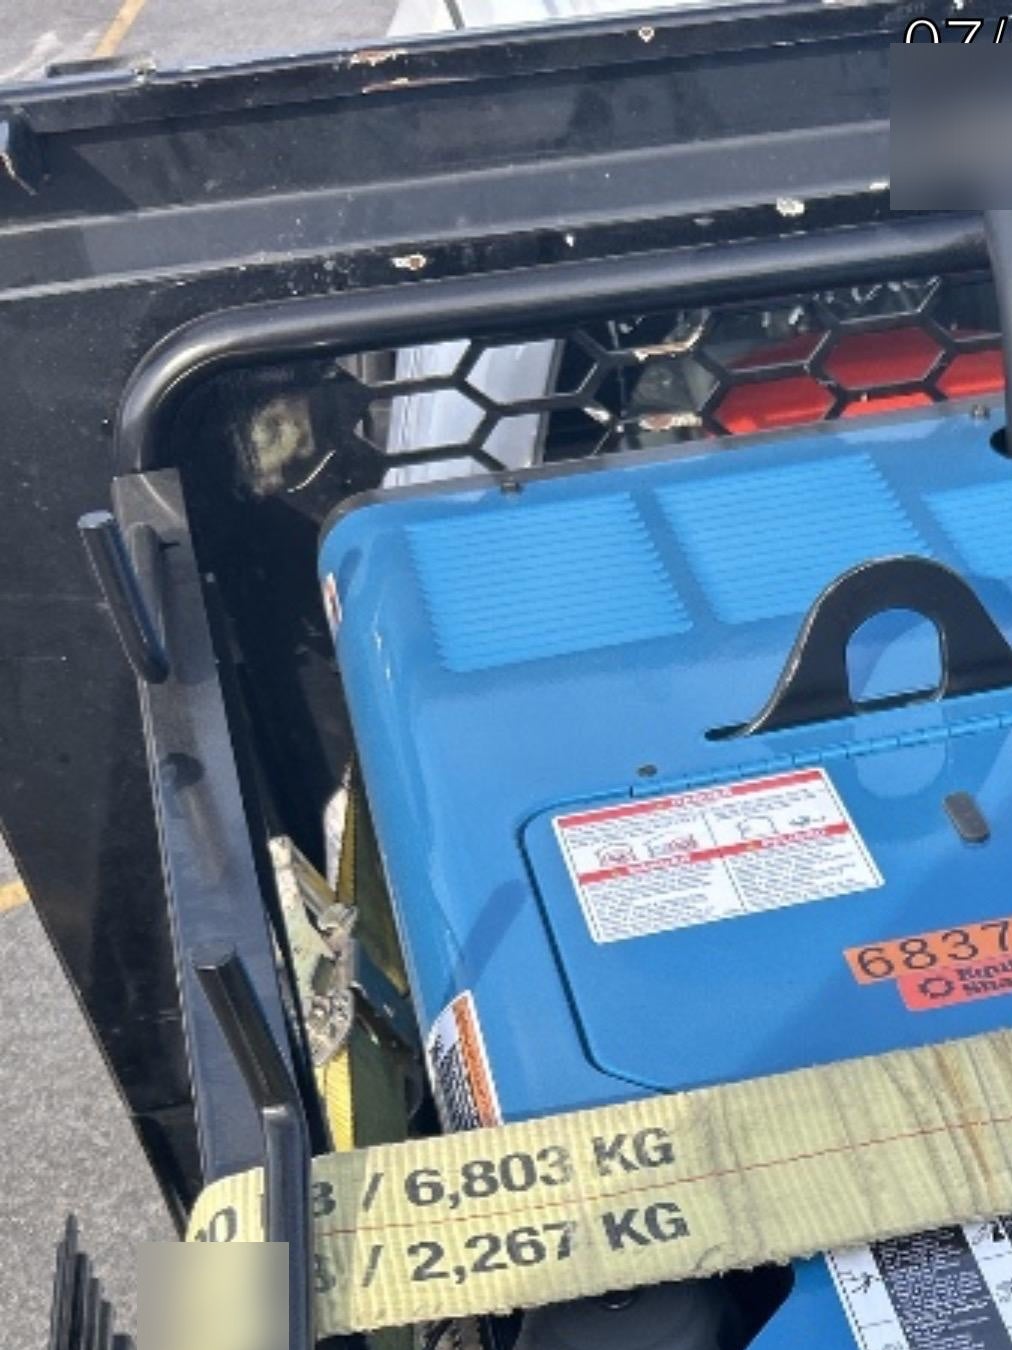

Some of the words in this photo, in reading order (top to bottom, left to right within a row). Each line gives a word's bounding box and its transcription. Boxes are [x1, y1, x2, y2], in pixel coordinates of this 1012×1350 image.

[405, 1145, 574, 1208] 6,803
[593, 1126, 676, 1176] KG
[406, 1221, 576, 1285] 2,267
[602, 1201, 691, 1251] KG
